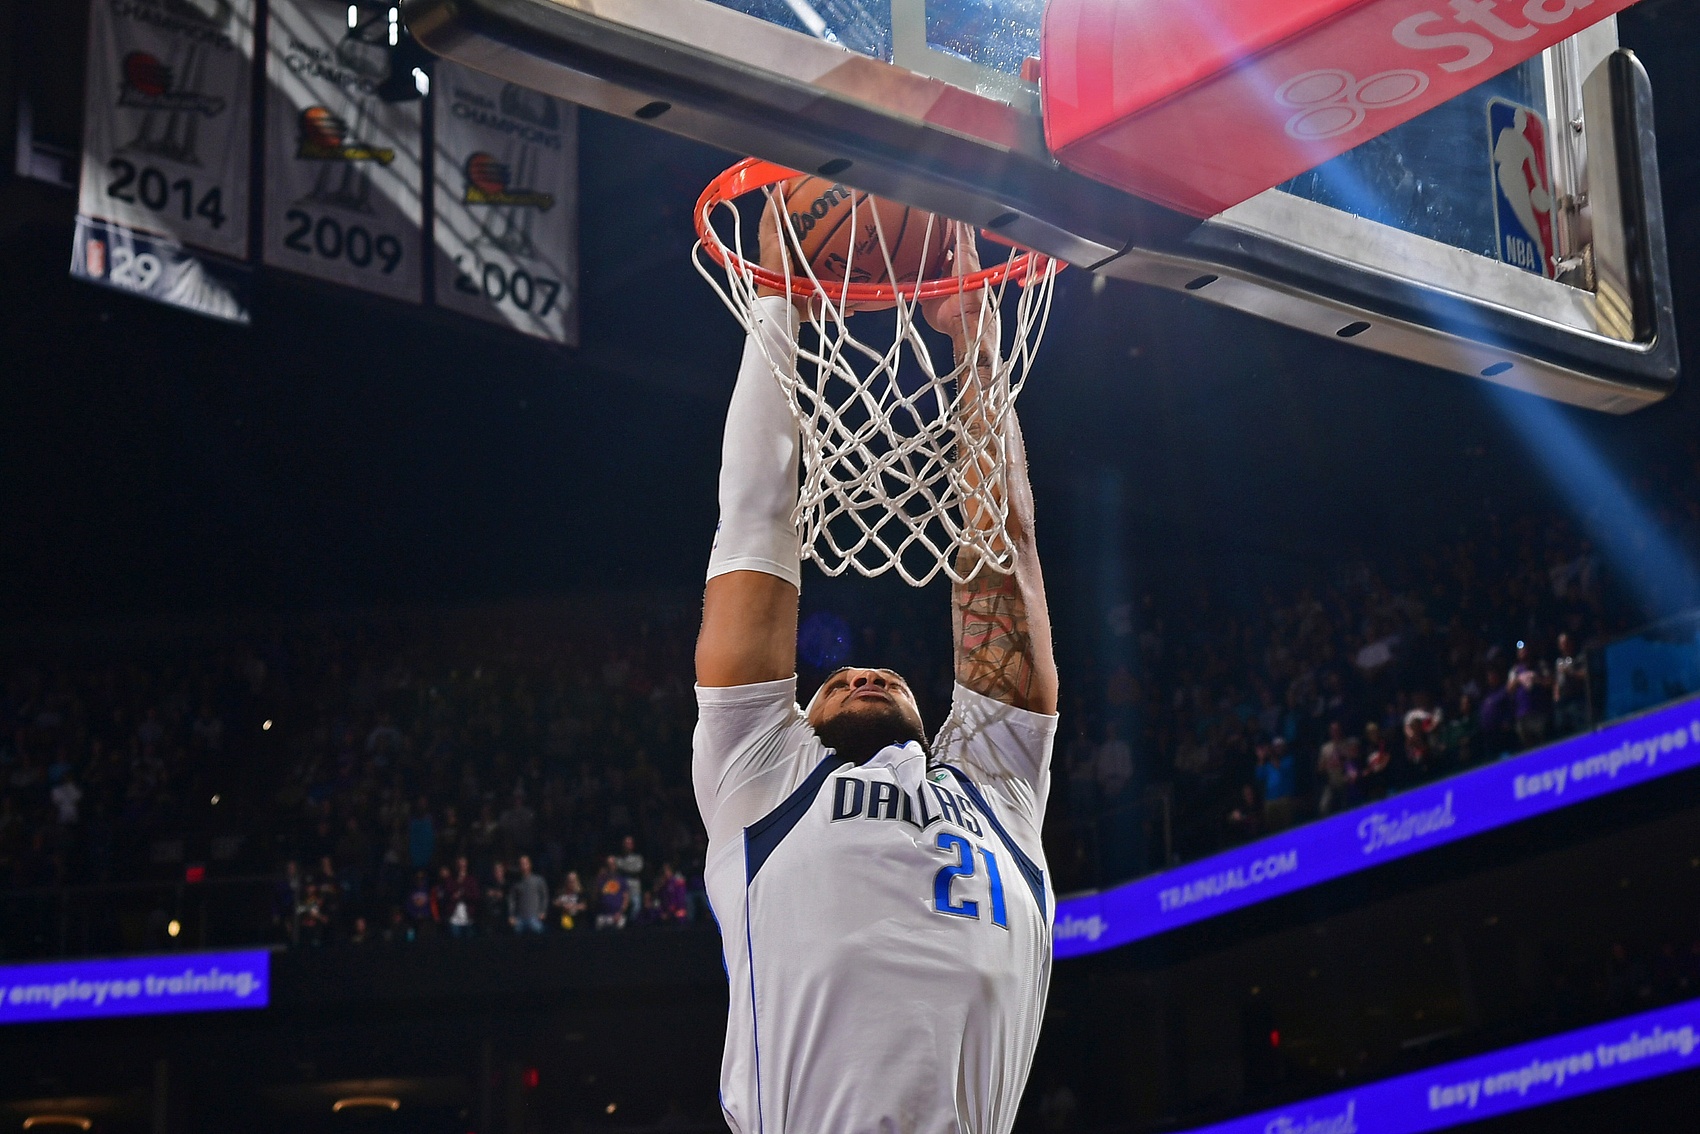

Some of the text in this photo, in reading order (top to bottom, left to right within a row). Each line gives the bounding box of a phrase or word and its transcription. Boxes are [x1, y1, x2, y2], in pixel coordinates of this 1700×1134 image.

[107, 158, 226, 229] 2014
[110, 246, 161, 290] 29
[284, 209, 402, 274] 2009
[1505, 234, 1535, 272] NBA
[455, 253, 561, 317] 2007
[1514, 765, 1567, 800] Easy
[1570, 728, 1688, 781] employee
[830, 776, 984, 840] DALLAS
[932, 831, 1009, 931] 21
[1158, 849, 1298, 914] TRAINUAL.COM
[9, 978, 141, 1010] employee
[145, 966, 261, 999] training.
[1428, 1079, 1480, 1111] Easy
[1482, 1051, 1594, 1097] employee
